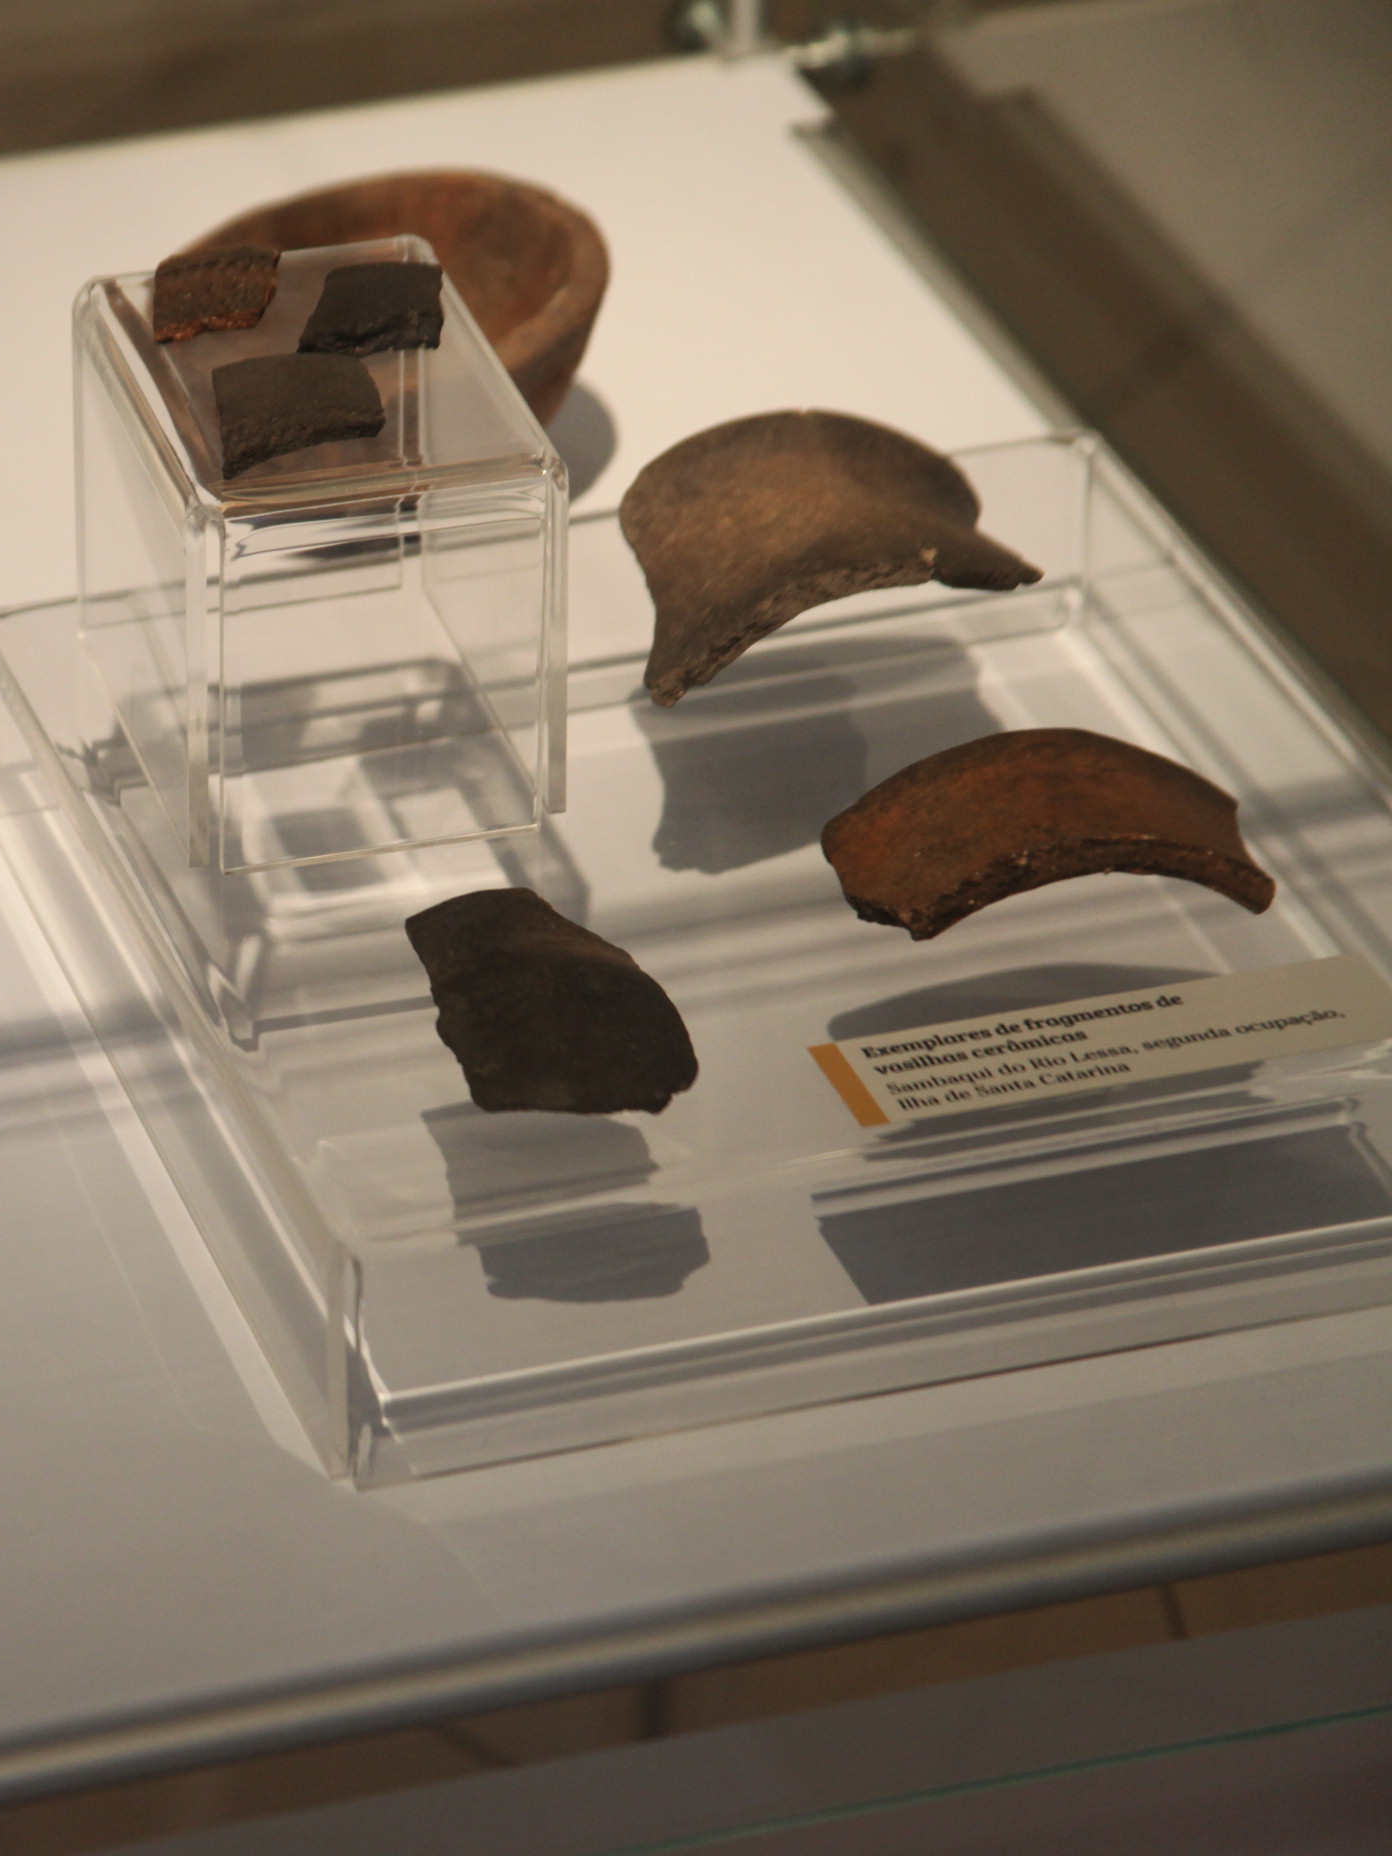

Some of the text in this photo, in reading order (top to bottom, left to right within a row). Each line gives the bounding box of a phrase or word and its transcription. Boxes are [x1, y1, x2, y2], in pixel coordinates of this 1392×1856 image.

[861, 994, 1185, 1060] Exemplares de fragmentos de
[873, 1030, 1088, 1075] vasilhas cerâmicas
[886, 1008, 1346, 1094] Sambaqui do Rio Lessa, segunda ocupação,
[897, 1062, 1131, 1111] Ilha de Santa Catarina
